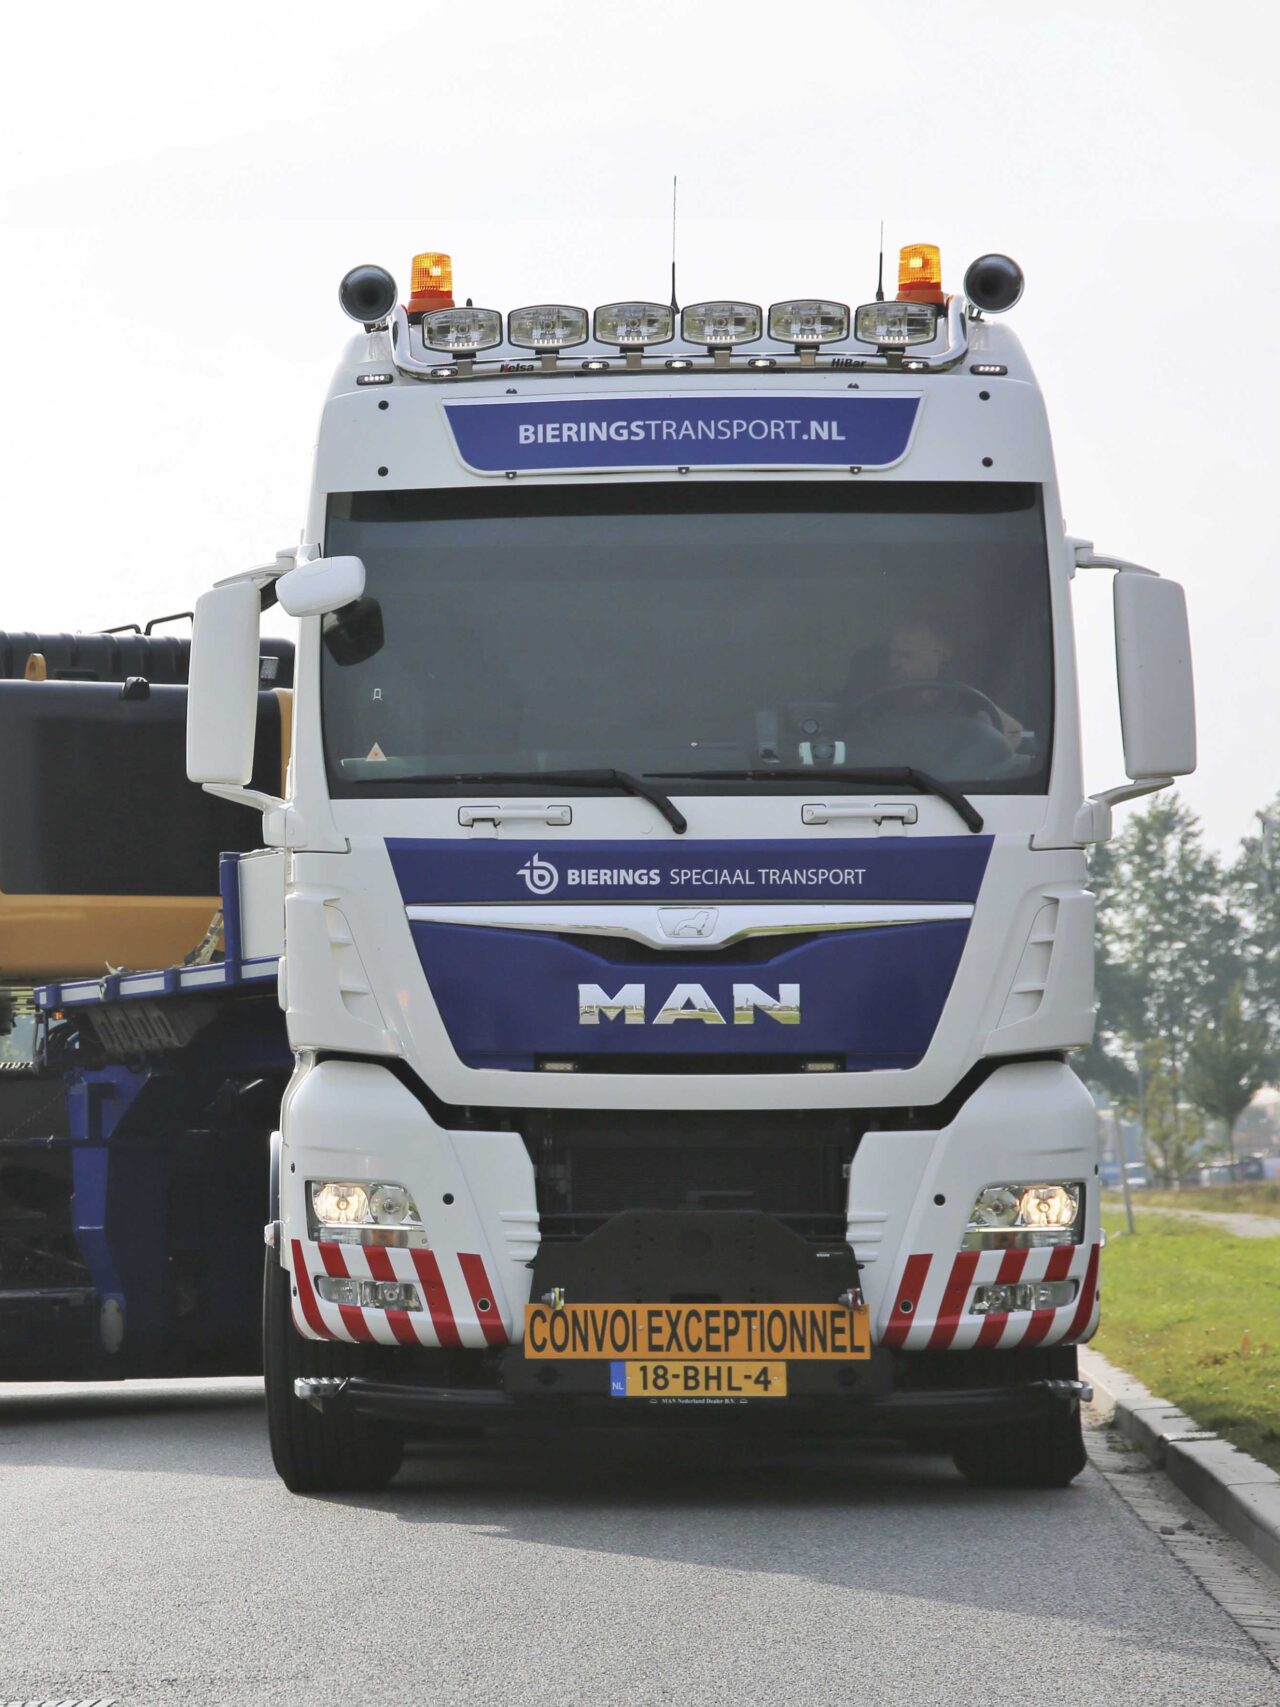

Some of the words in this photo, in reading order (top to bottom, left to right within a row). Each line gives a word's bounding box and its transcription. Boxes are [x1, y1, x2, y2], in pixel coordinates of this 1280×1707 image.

[500, 363, 534, 372] Kelsa
[831, 357, 867, 368] HiBar
[518, 419, 846, 444] BIERINGSTRANSPORT.NL
[567, 868, 661, 886] BIERINGS
[669, 868, 755, 886] SPECIAAL
[757, 868, 866, 886] TRANSPORT
[578, 983, 801, 1025] MAN
[528, 1309, 638, 1353] CONVOI
[647, 1309, 865, 1353] EXCEPTIONNEL
[612, 1382, 624, 1391] NL
[639, 1364, 772, 1392] 18-BHL-4
